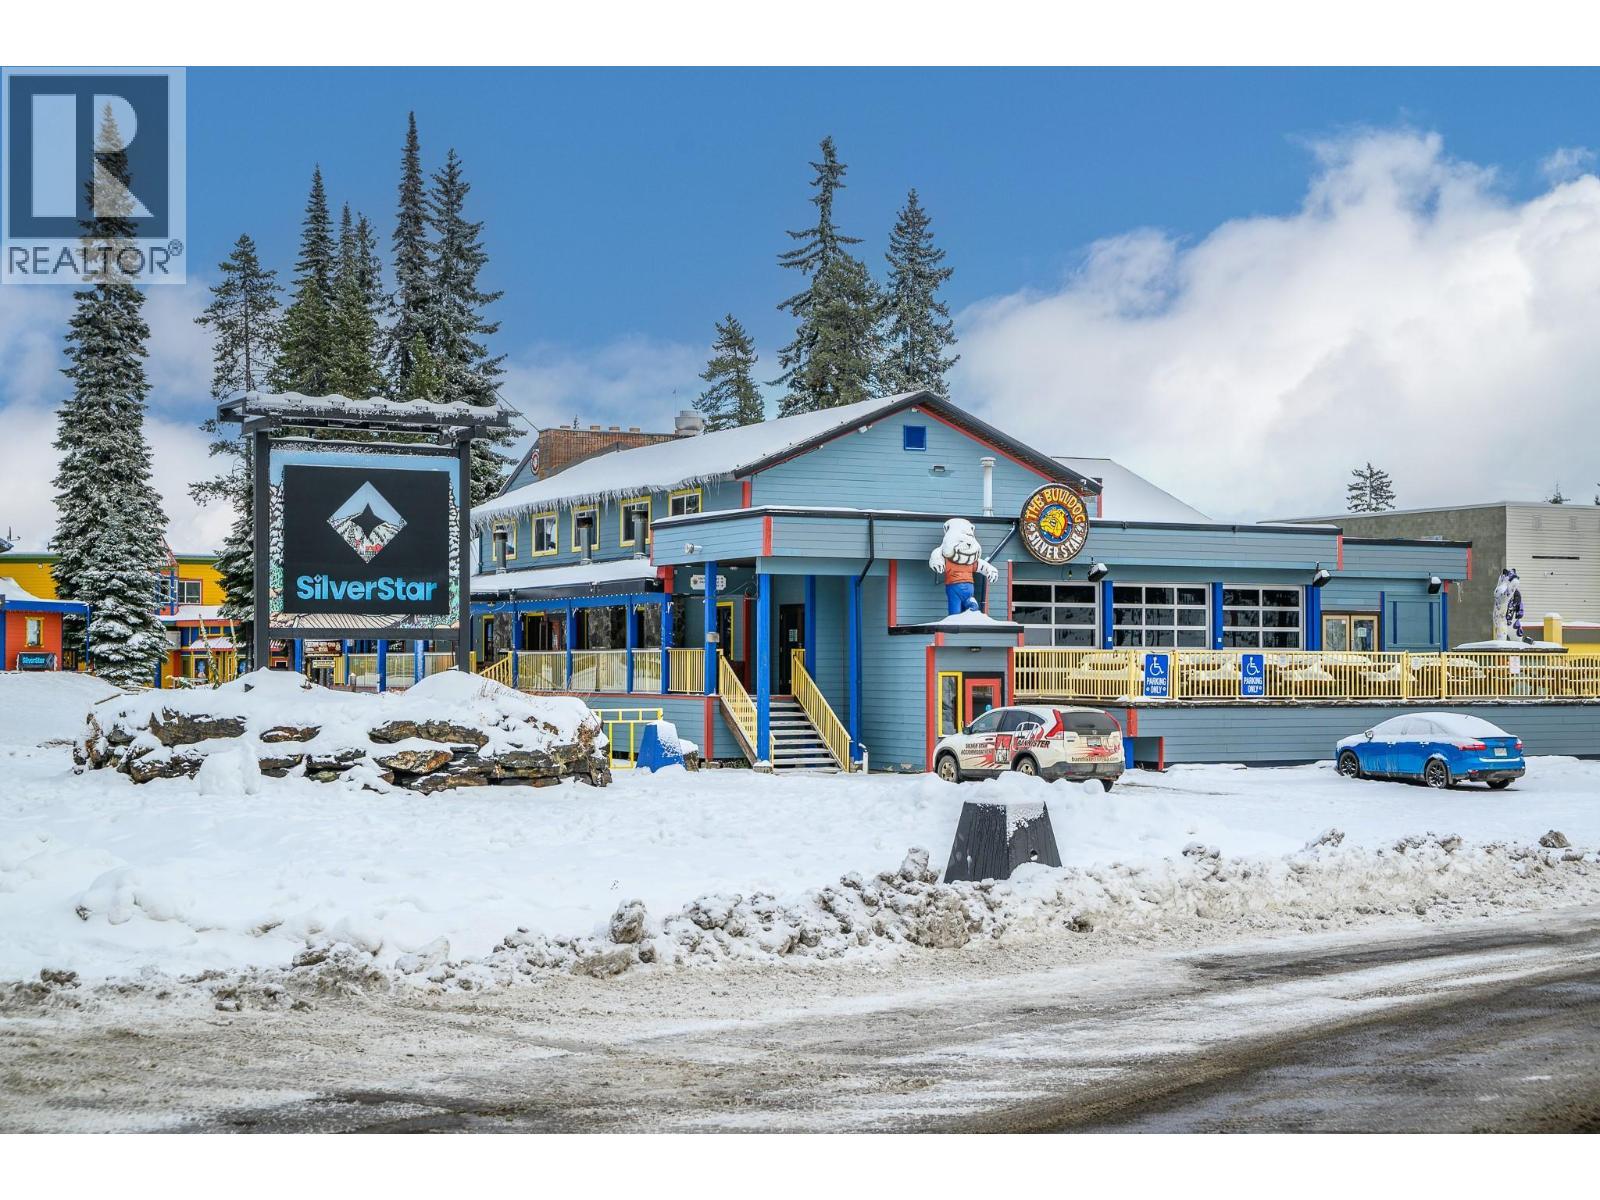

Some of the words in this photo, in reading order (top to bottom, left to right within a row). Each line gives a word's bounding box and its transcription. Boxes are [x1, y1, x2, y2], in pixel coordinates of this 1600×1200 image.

[1025, 494, 1045, 519] THE
[1043, 487, 1086, 523] BULLDOG
[1028, 531, 1059, 559] SILVER
[1060, 533, 1083, 558] STAR
[296, 573, 438, 601] SilverStar
[1146, 677, 1167, 686] PARKING
[1243, 676, 1263, 685] PARKING
[1150, 685, 1163, 694] ONLY
[1247, 685, 1259, 693] ONLY
[1016, 739, 1051, 749] BANNISTER
